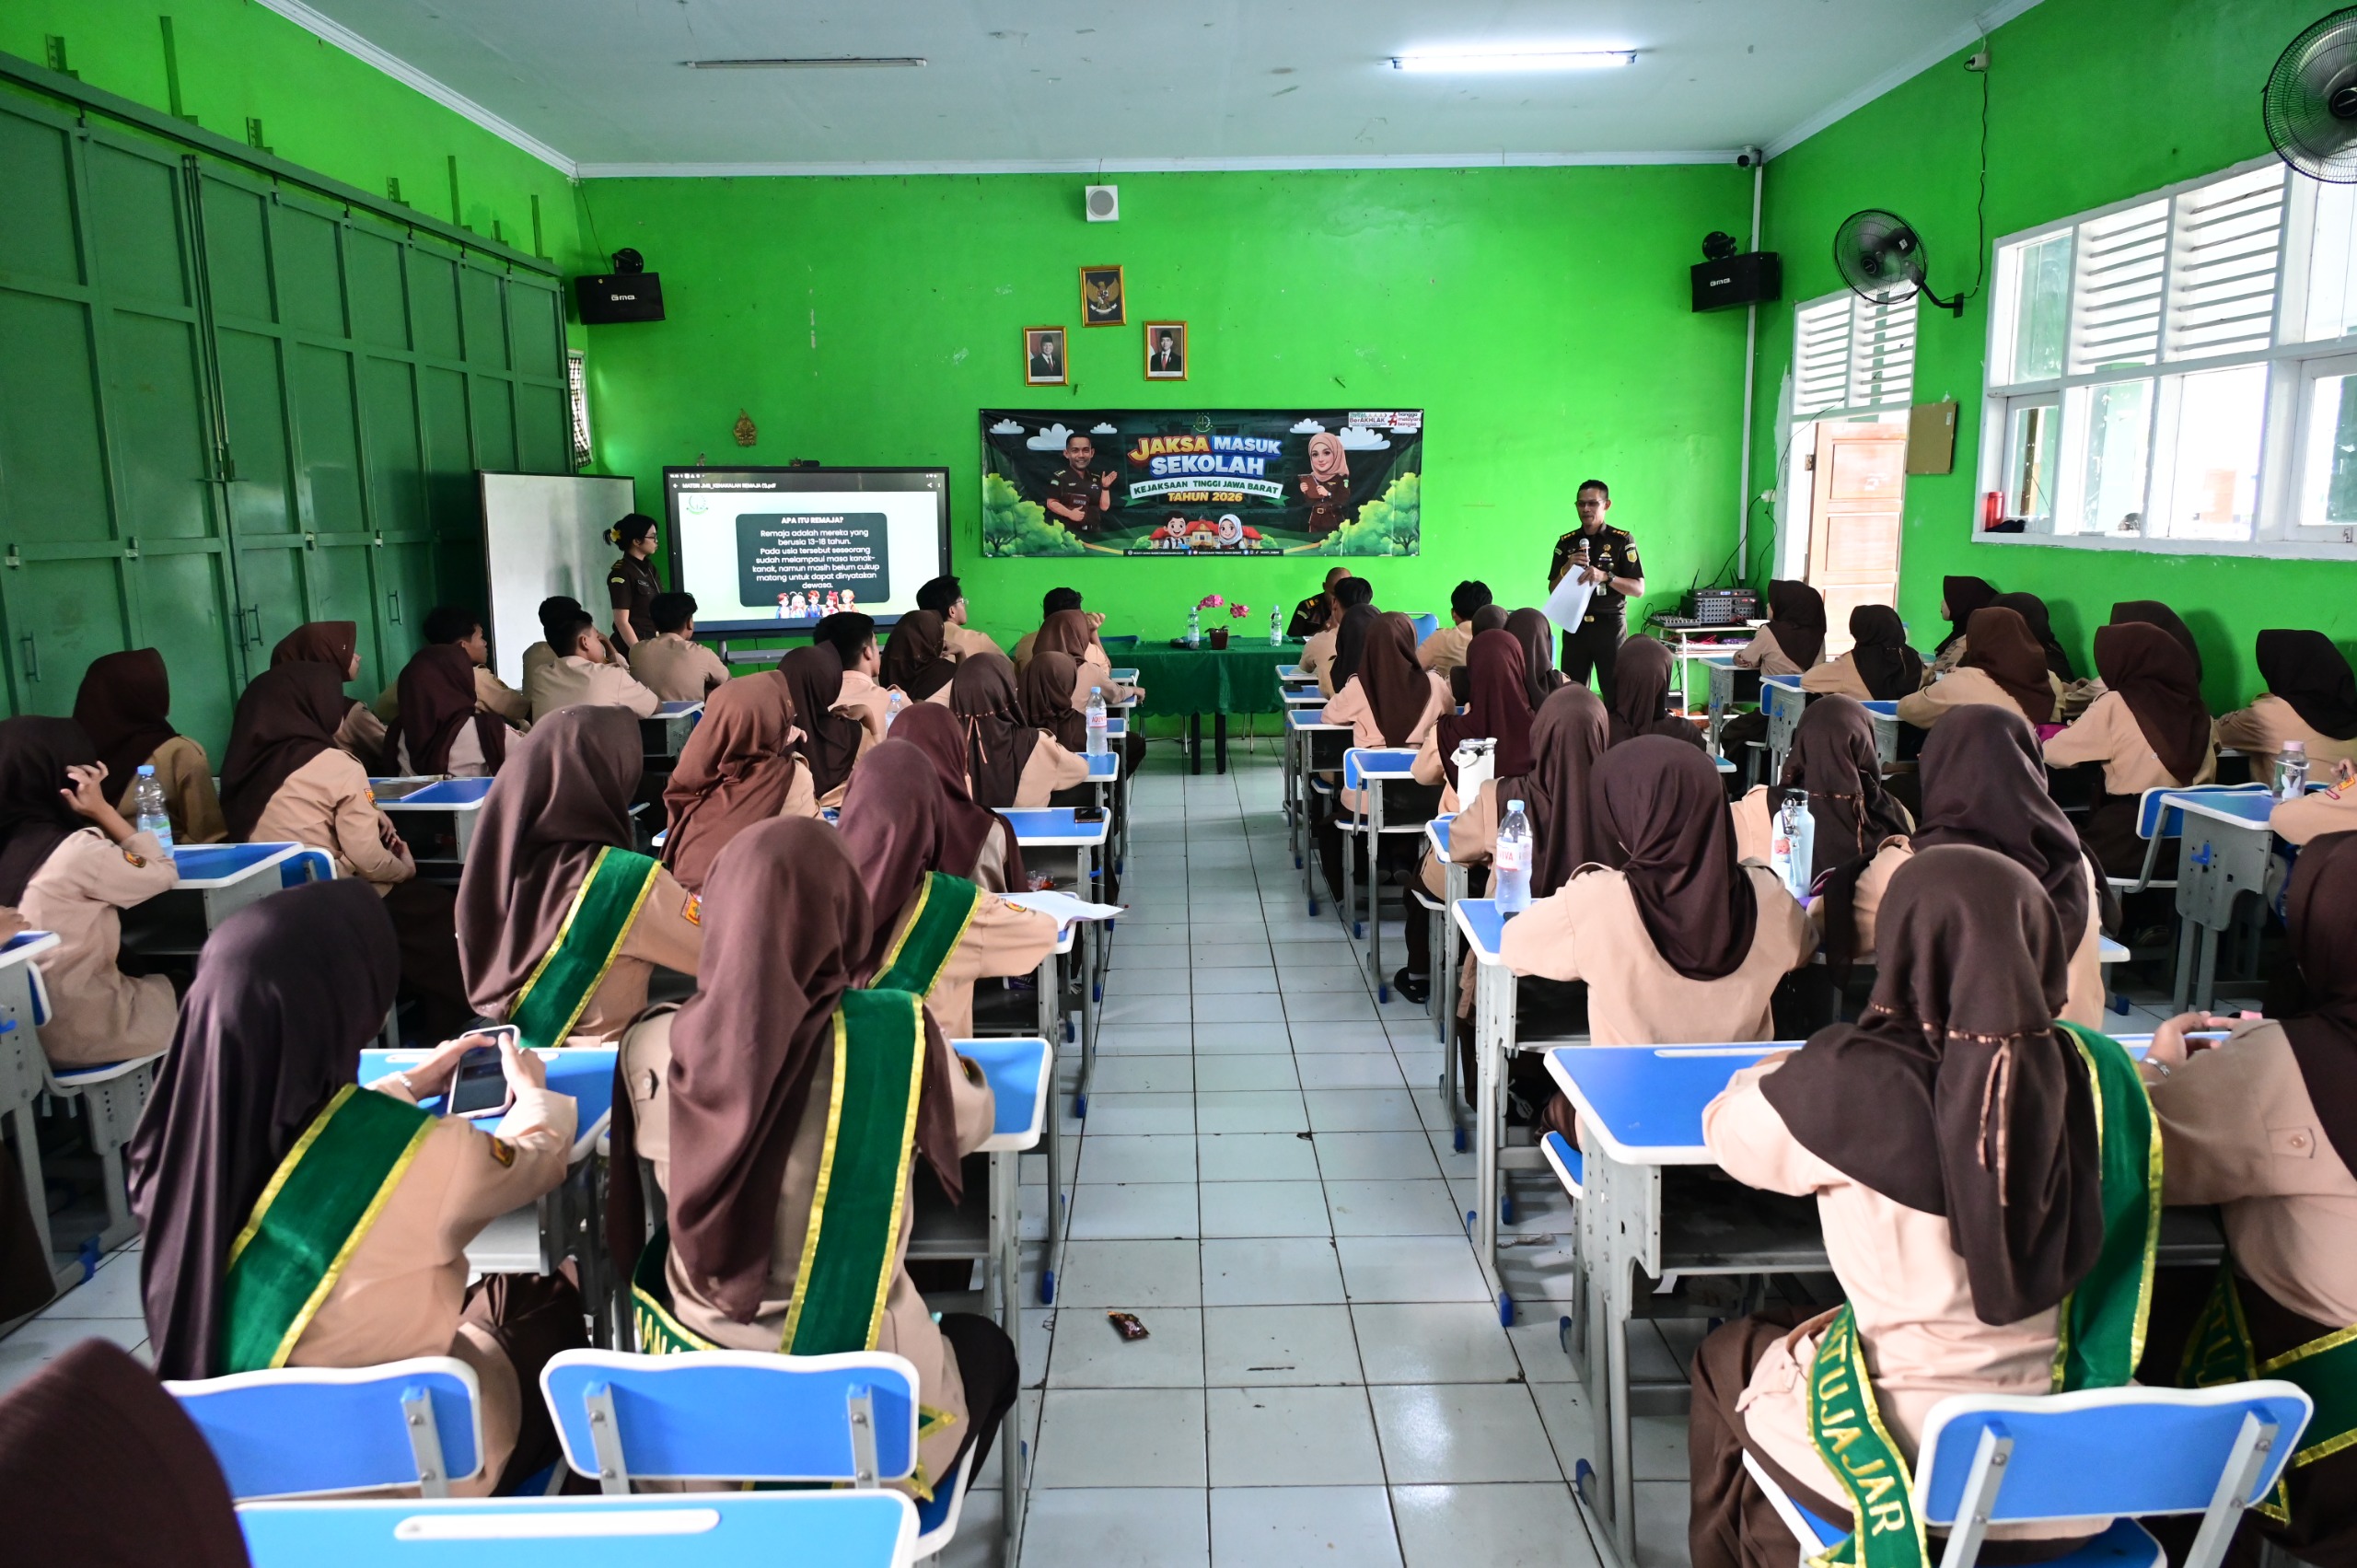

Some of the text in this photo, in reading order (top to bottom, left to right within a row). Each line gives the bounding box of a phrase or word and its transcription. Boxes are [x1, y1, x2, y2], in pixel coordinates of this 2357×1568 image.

[1128, 436, 1282, 465] JAKSA MASUK
[1151, 455, 1265, 477] SEKOLAH
[1133, 480, 1279, 494] KEJAKSAAN TINGGI JAWA BARAT
[1167, 492, 1243, 502] TAHUN 2026
[761, 529, 790, 539] Remaja
[850, 529, 868, 538] yang
[831, 547, 871, 555] seseorang
[756, 556, 780, 564] sudah
[782, 555, 825, 564] melampaui
[752, 565, 777, 574] kanak,
[857, 563, 879, 572] cukup
[756, 575, 787, 583] matang
[811, 573, 834, 582] dapat
[835, 572, 877, 582] dinyatakan
